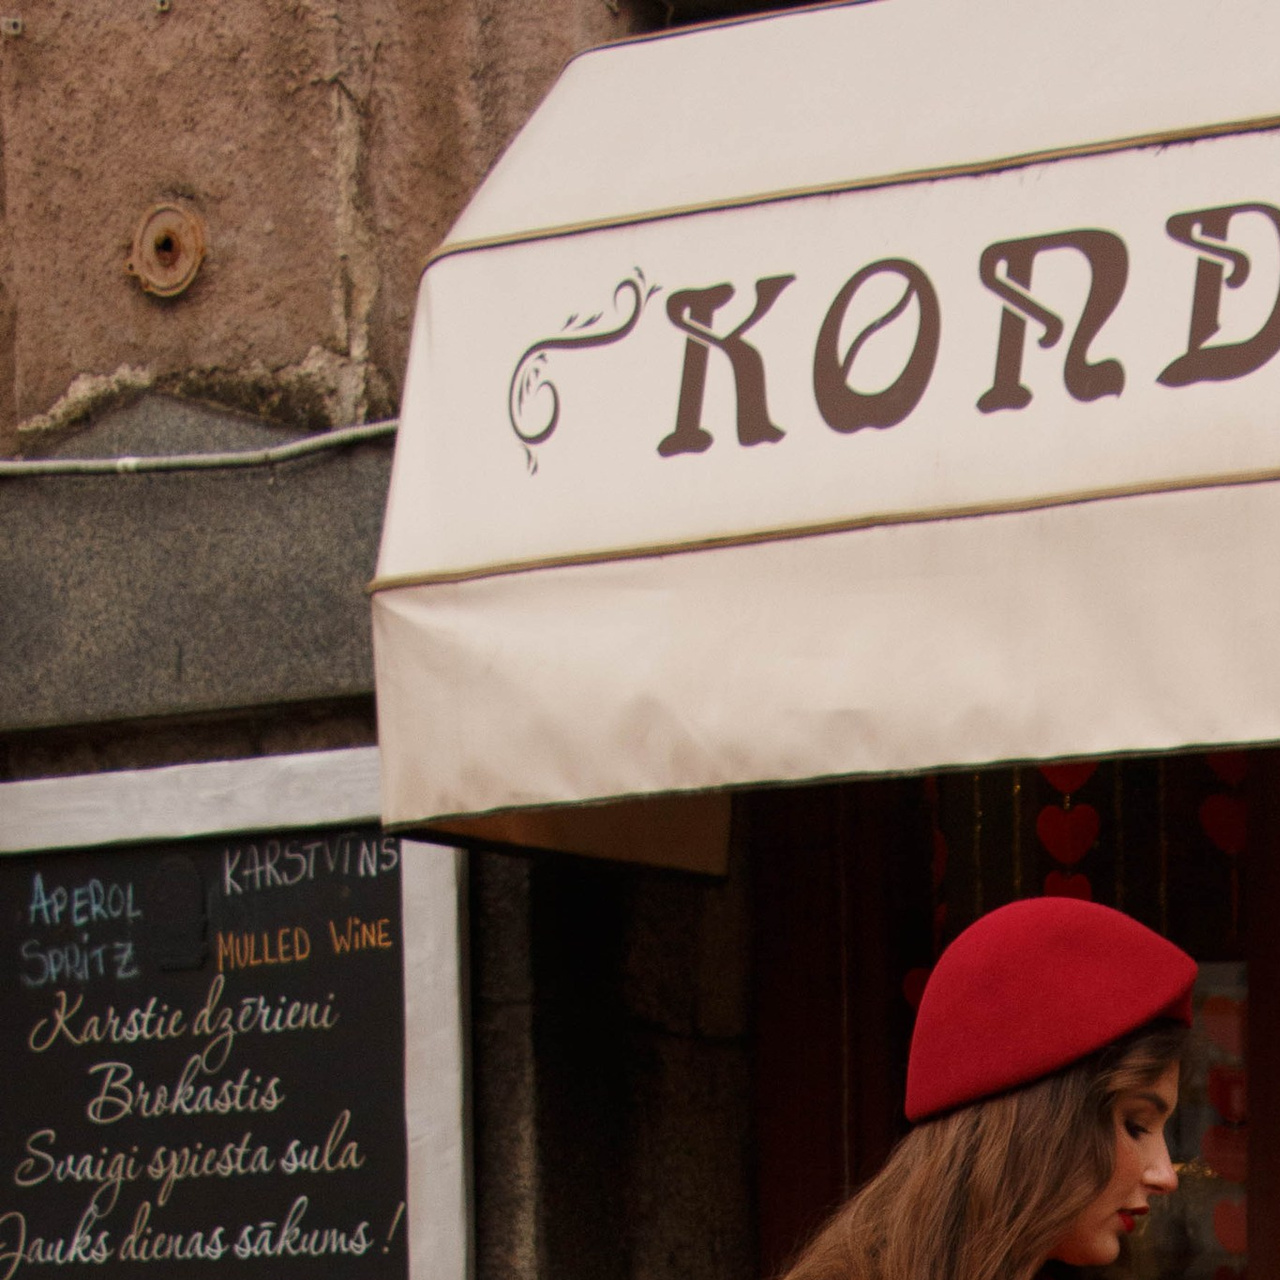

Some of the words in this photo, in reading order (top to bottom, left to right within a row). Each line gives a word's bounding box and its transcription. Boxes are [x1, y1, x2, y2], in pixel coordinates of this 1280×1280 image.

[29, 871, 142, 926] APEROL
[216, 926, 311, 973] MULLED
[29, 990, 188, 1051] Karstie
[193, 974, 340, 1073] dzērieni
[87, 1054, 285, 1123] Brokastis
[15, 1129, 142, 1217] Svaigi
[147, 1132, 276, 1207] spiesta
[280, 1109, 366, 1175] sula
[119, 1201, 230, 1260] dienas
